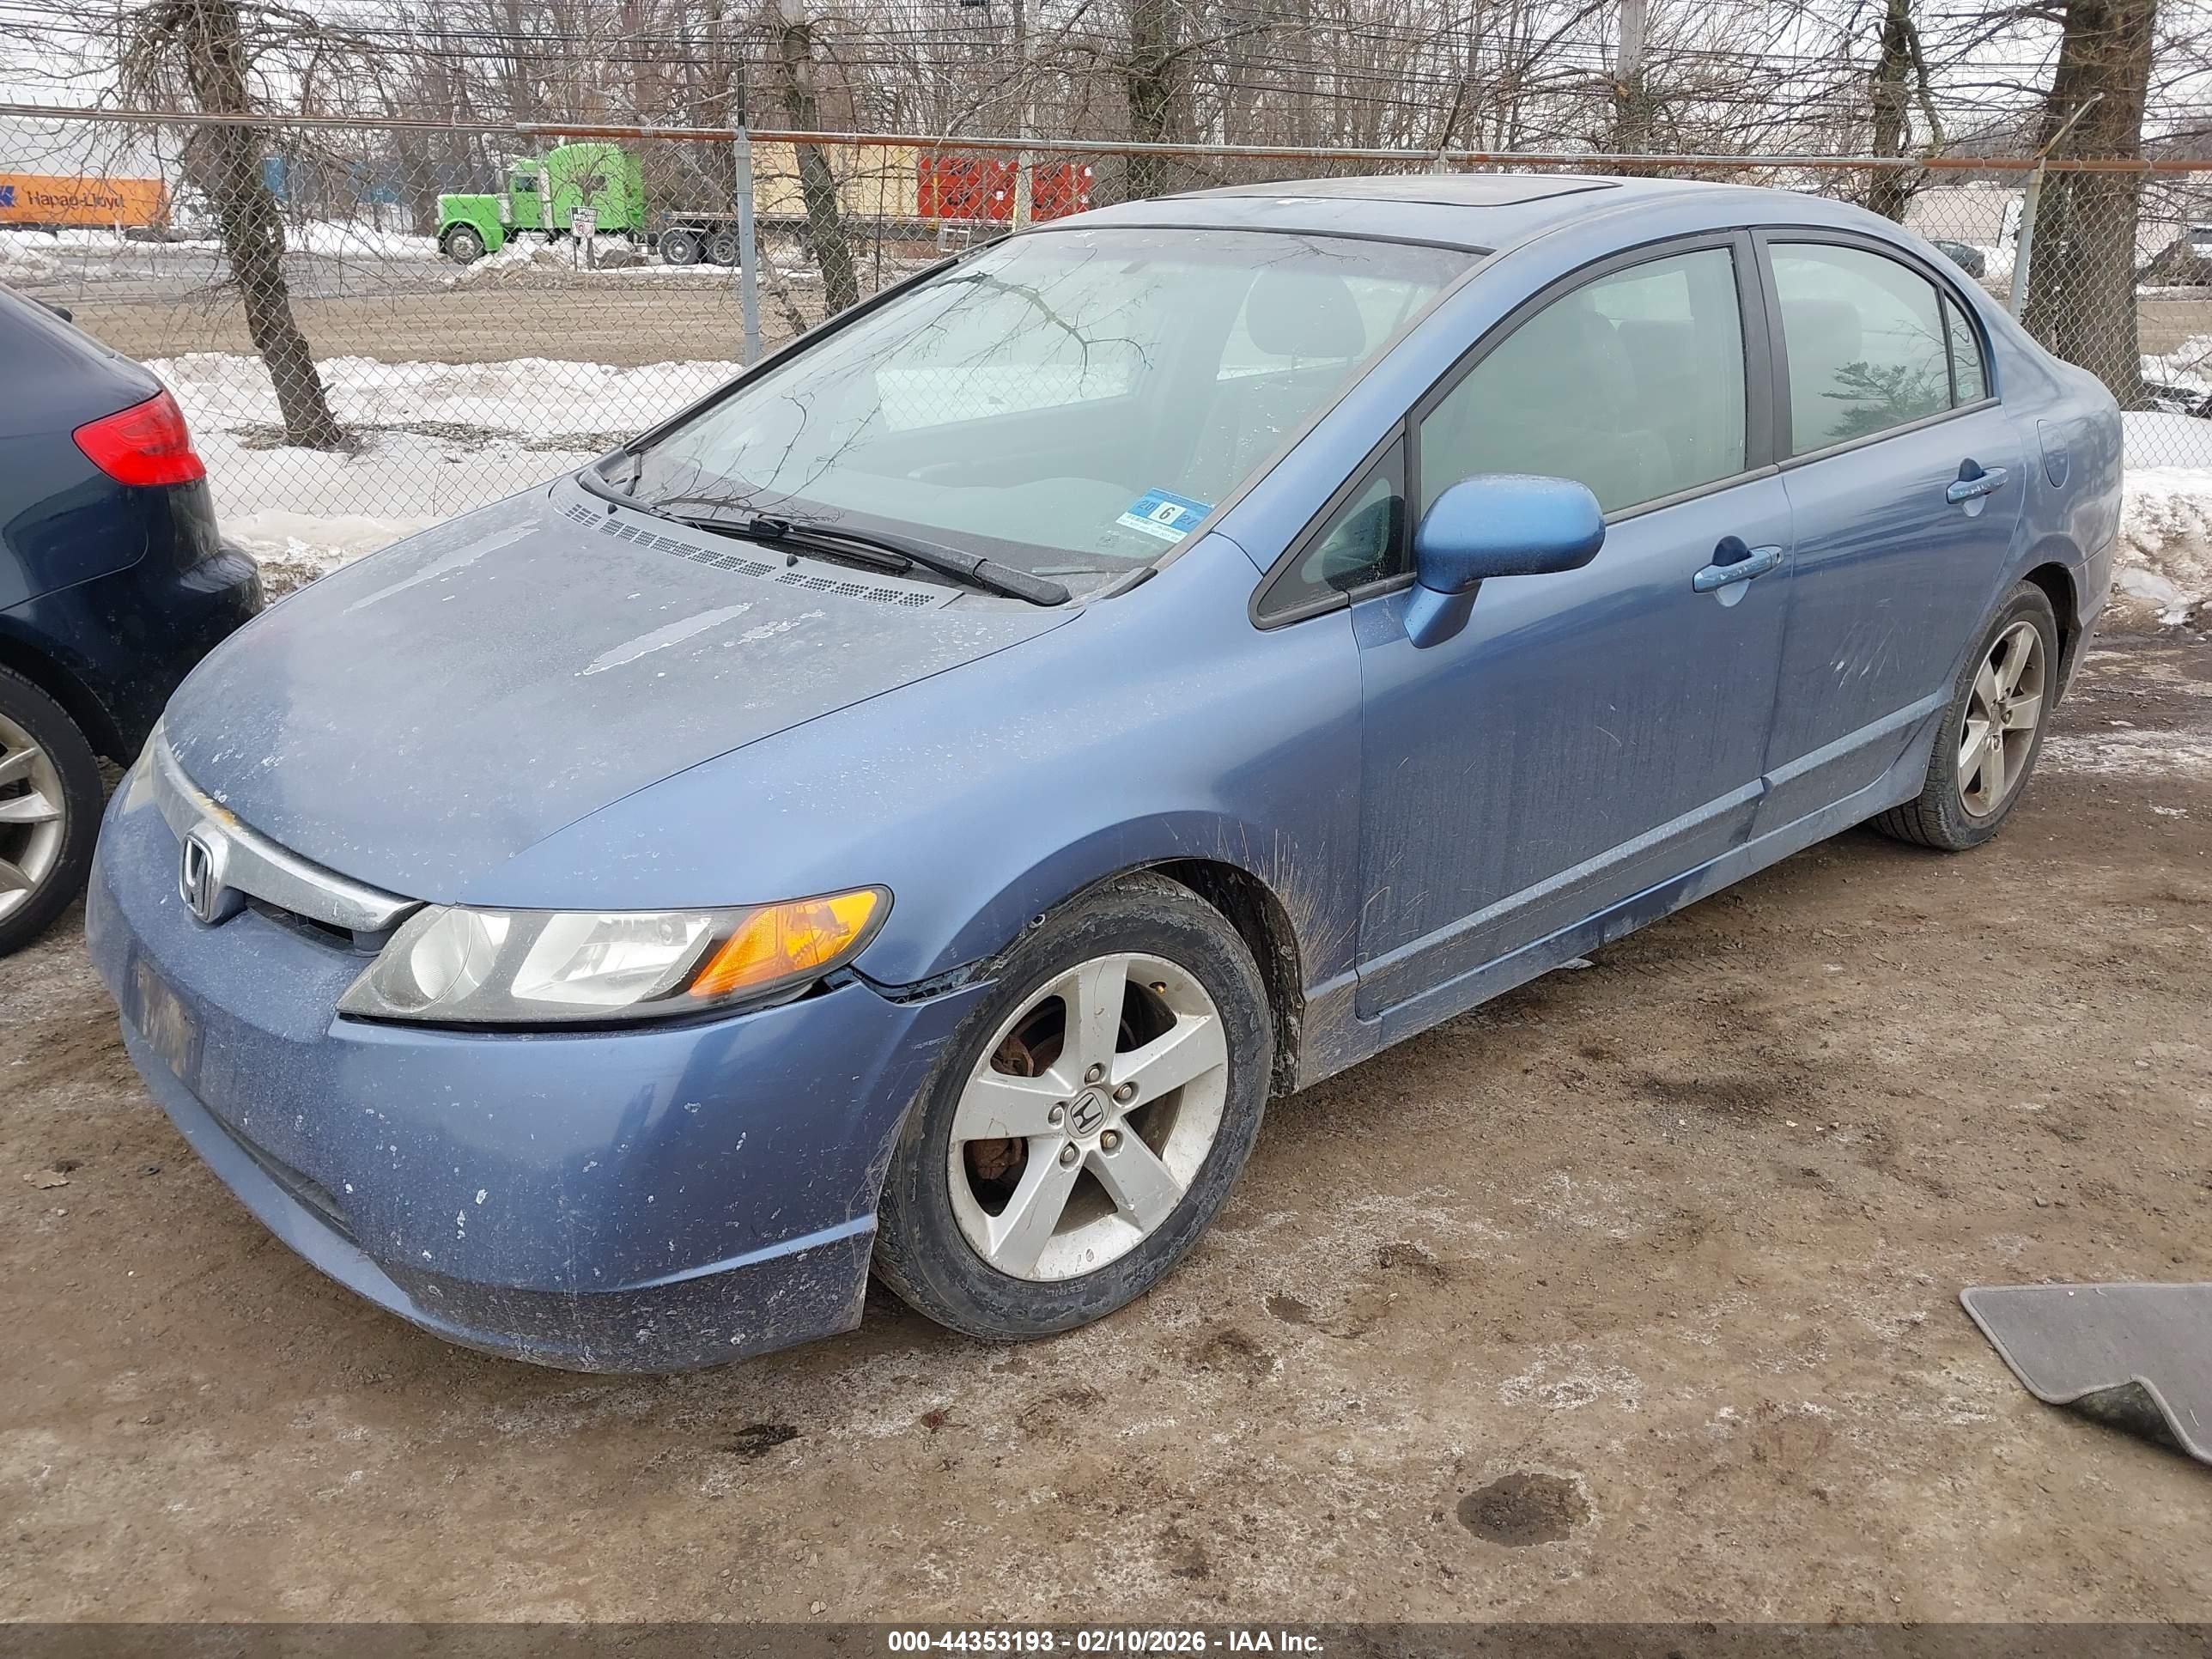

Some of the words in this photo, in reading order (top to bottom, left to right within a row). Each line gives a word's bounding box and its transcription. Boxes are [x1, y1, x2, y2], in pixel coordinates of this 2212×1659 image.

[27, 191, 125, 210] Hapag-Lloyd
[1139, 500, 1157, 512] 20
[1158, 506, 1176, 520] 6
